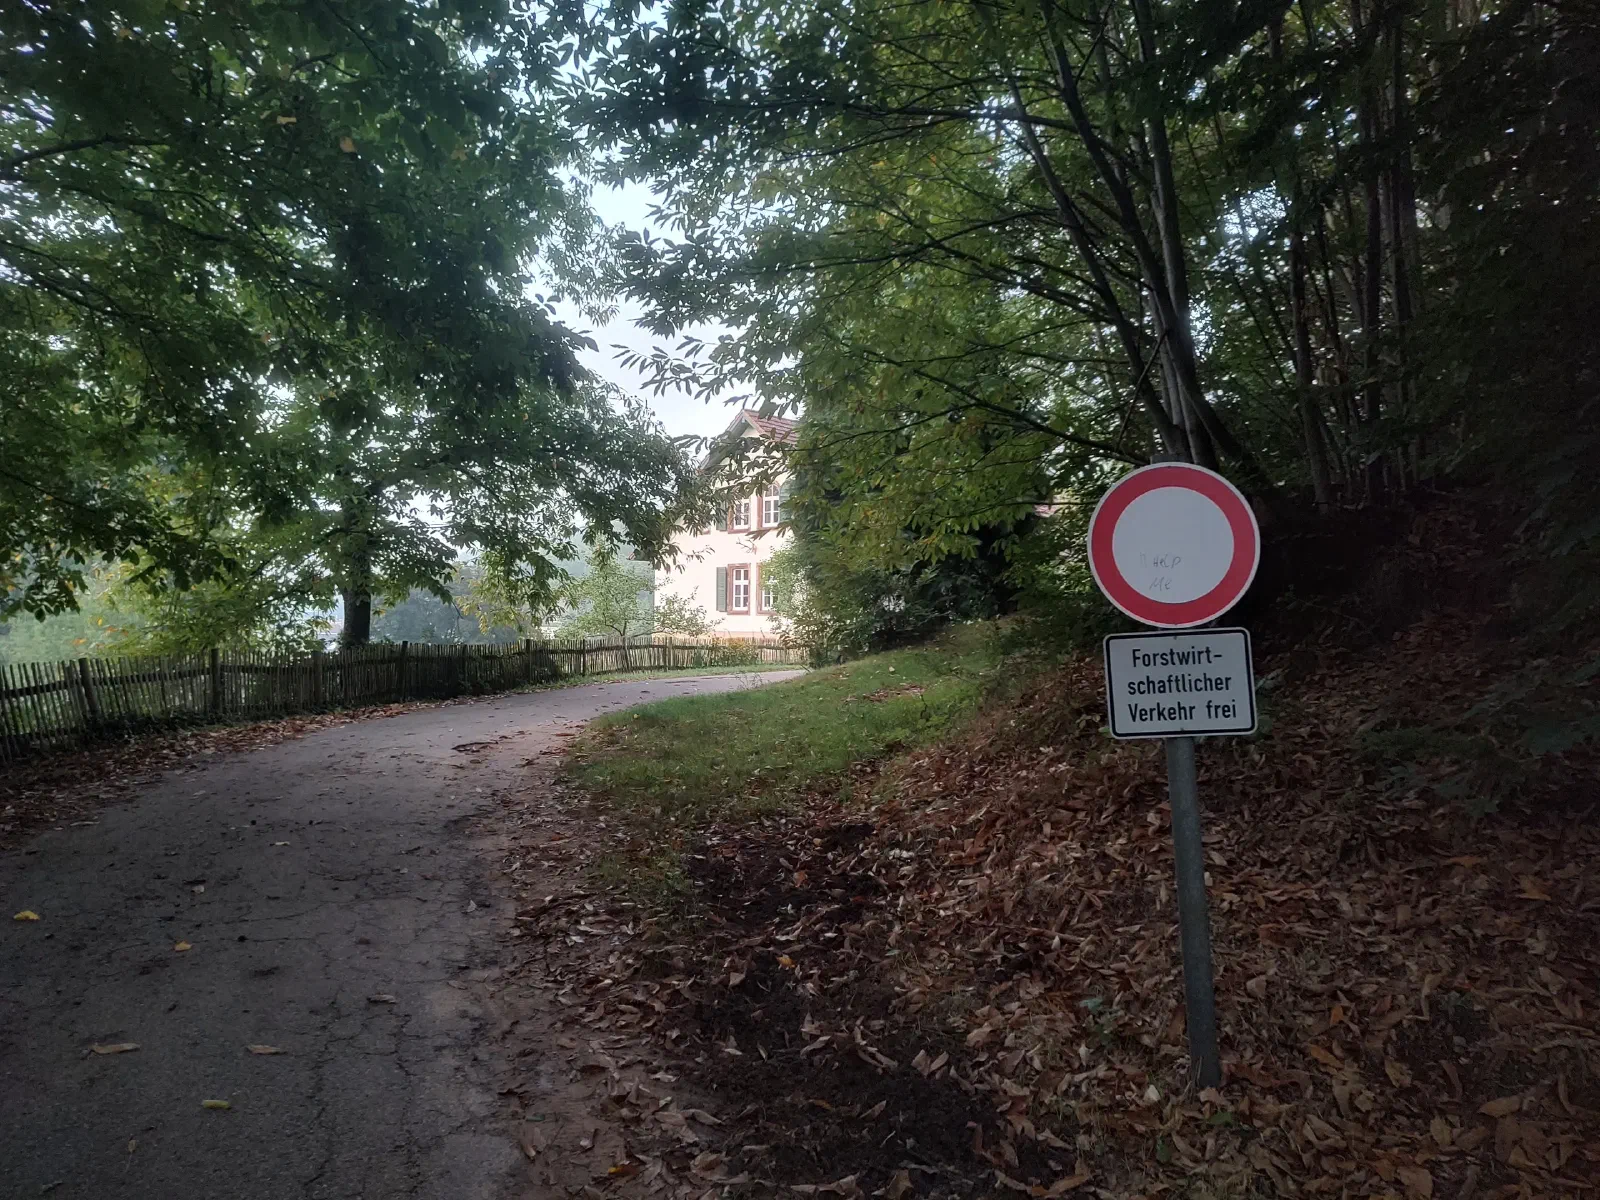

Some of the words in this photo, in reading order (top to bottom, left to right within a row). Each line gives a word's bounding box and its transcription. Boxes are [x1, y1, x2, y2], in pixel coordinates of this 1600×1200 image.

[1132, 646, 1222, 667] Forstwirt-
[1127, 672, 1232, 695] schaftlicher
[1128, 701, 1195, 722] Verkehr
[1206, 699, 1236, 719] frei
